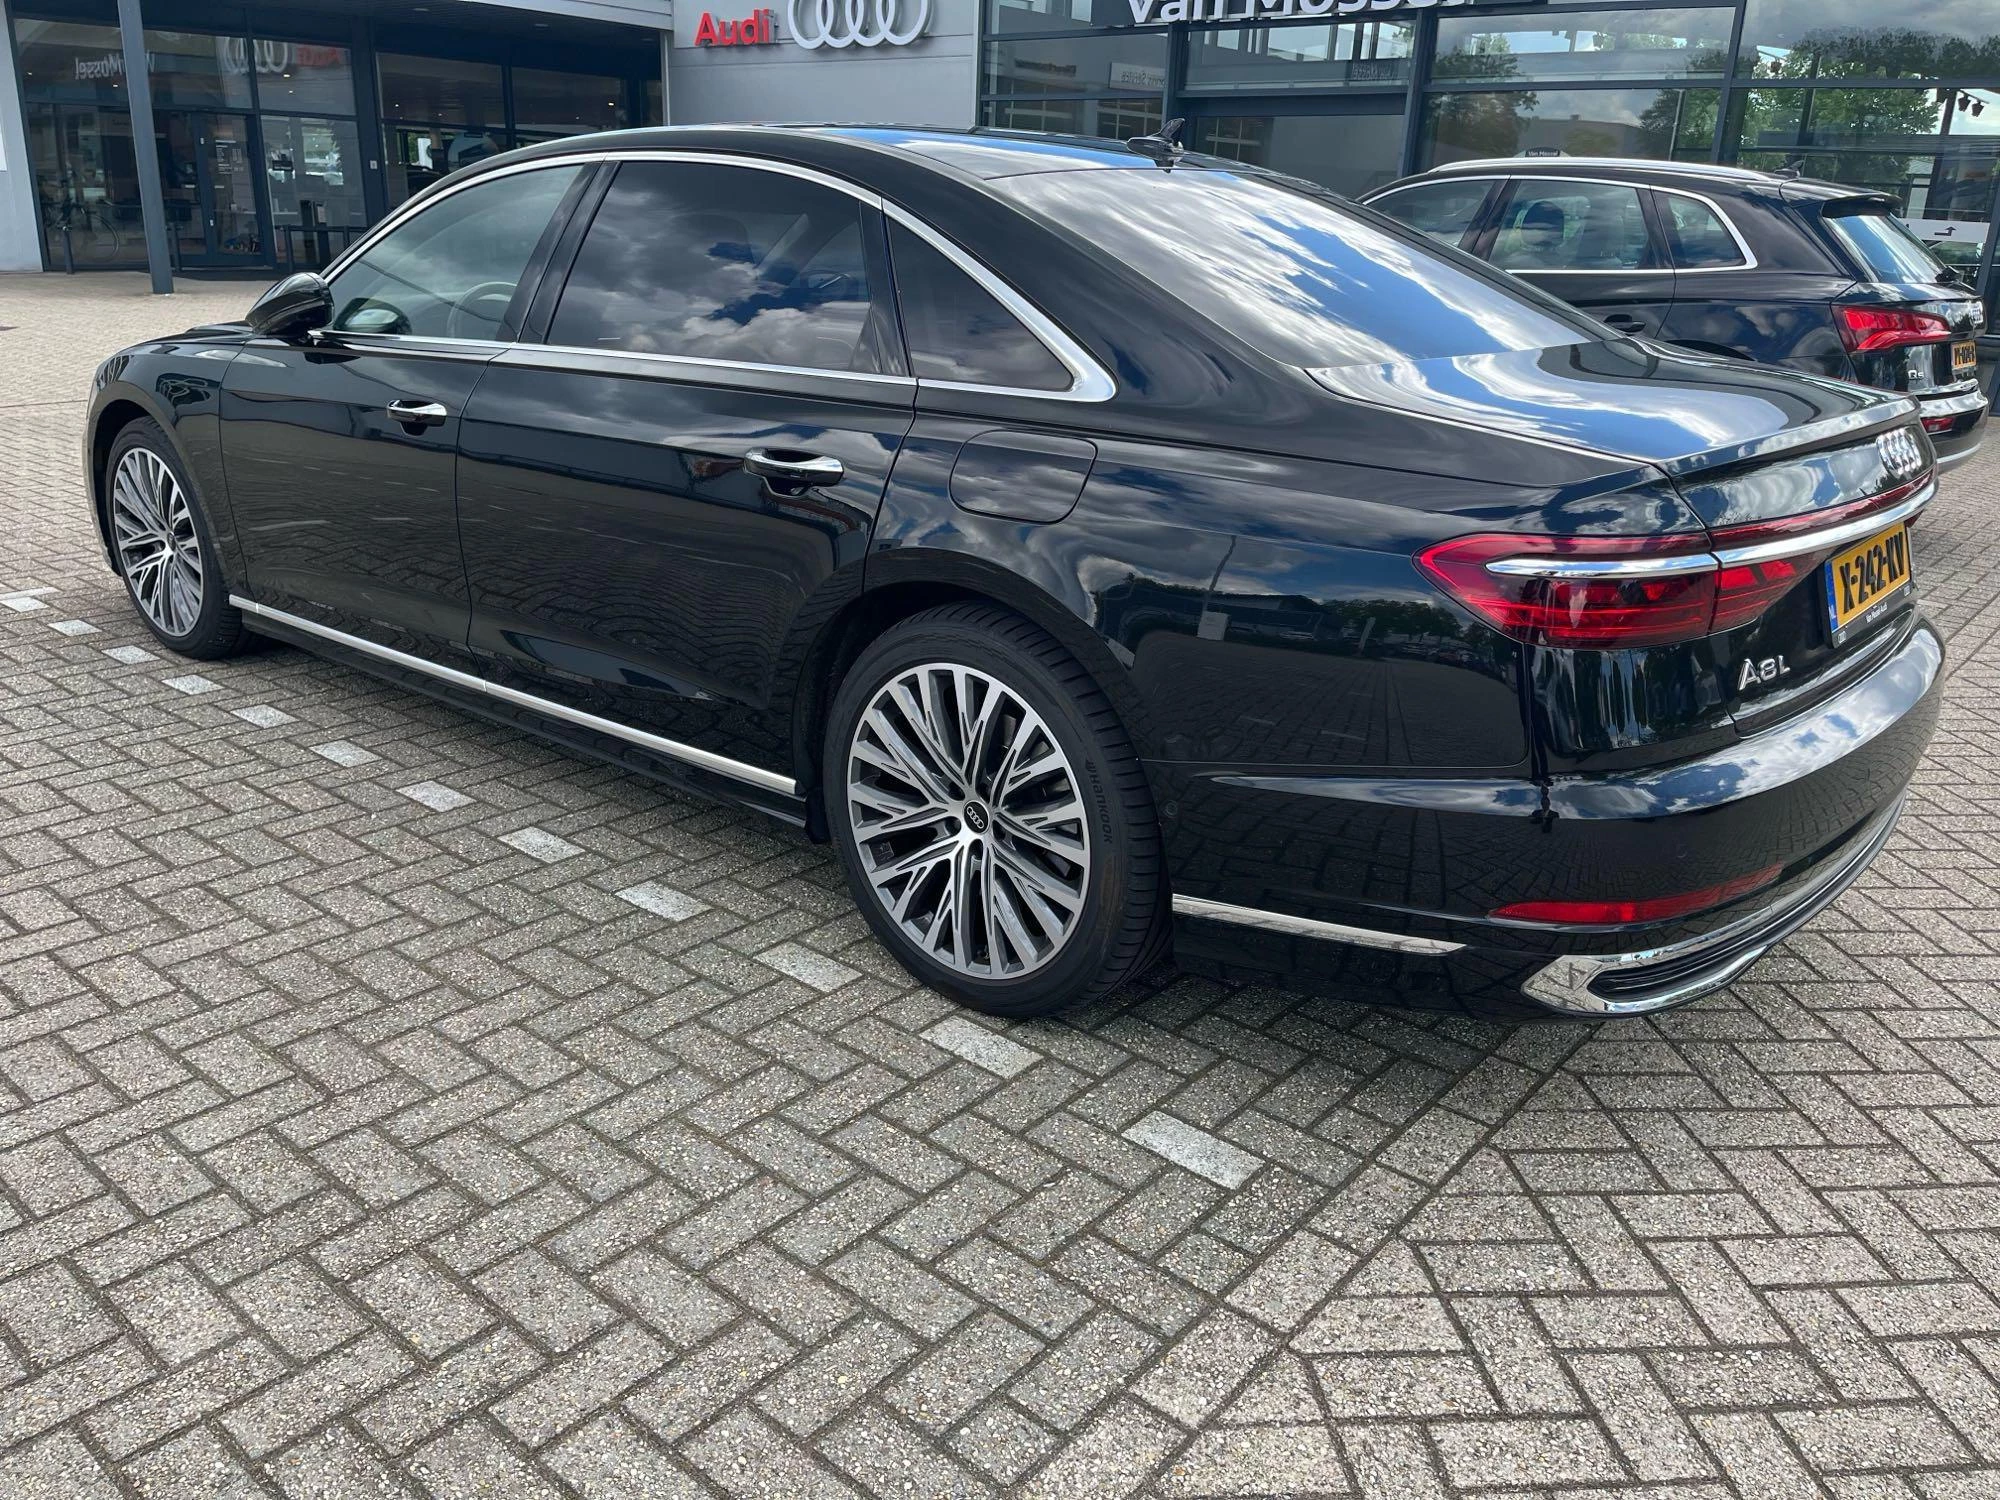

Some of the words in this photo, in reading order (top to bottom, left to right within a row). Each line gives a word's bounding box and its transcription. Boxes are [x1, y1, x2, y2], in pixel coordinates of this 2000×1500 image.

[694, 8, 771, 46] Audi
[1839, 531, 1904, 614] X-242-KV
[1738, 655, 1791, 691] A8L
